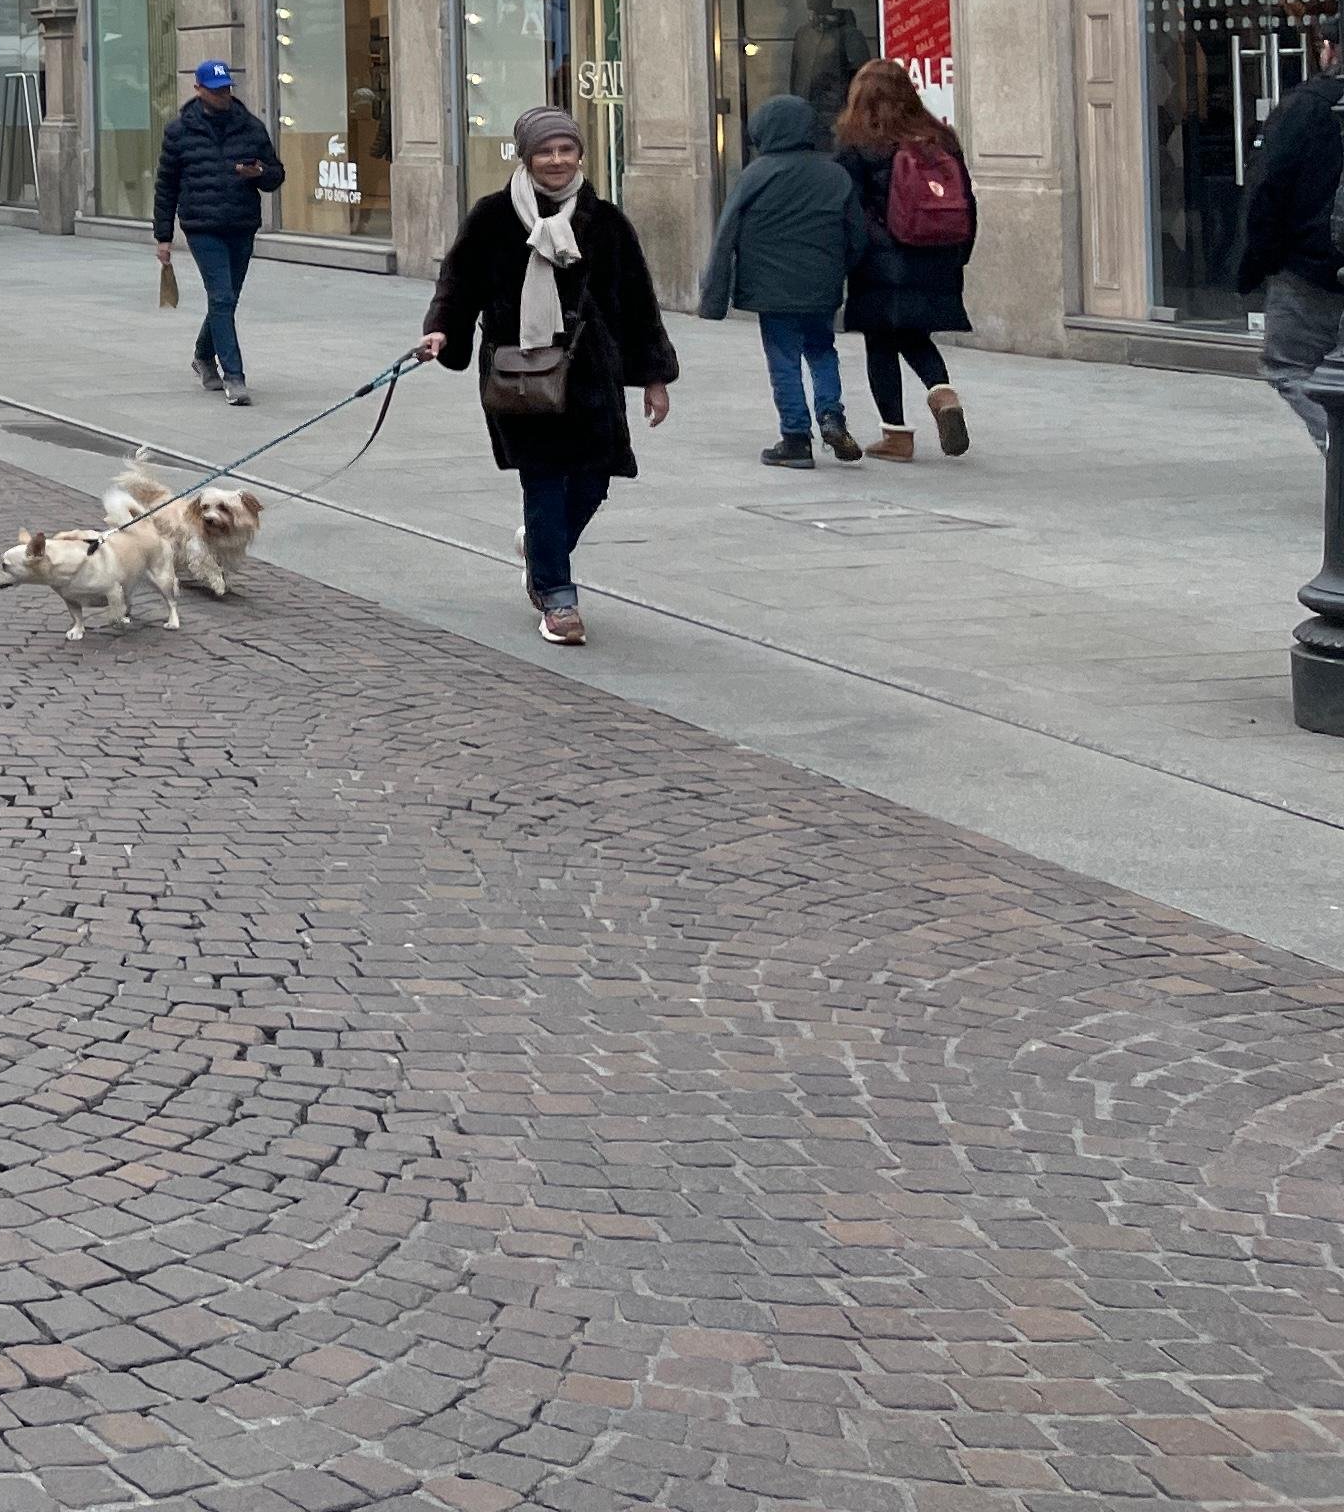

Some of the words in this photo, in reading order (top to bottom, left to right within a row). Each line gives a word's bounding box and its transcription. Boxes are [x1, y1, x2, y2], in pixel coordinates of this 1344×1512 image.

[578, 61, 624, 99] SAL
[894, 57, 953, 90] ALE
[319, 159, 357, 190] SALE
[314, 187, 324, 200] UP
[324, 188, 333, 201] TO
